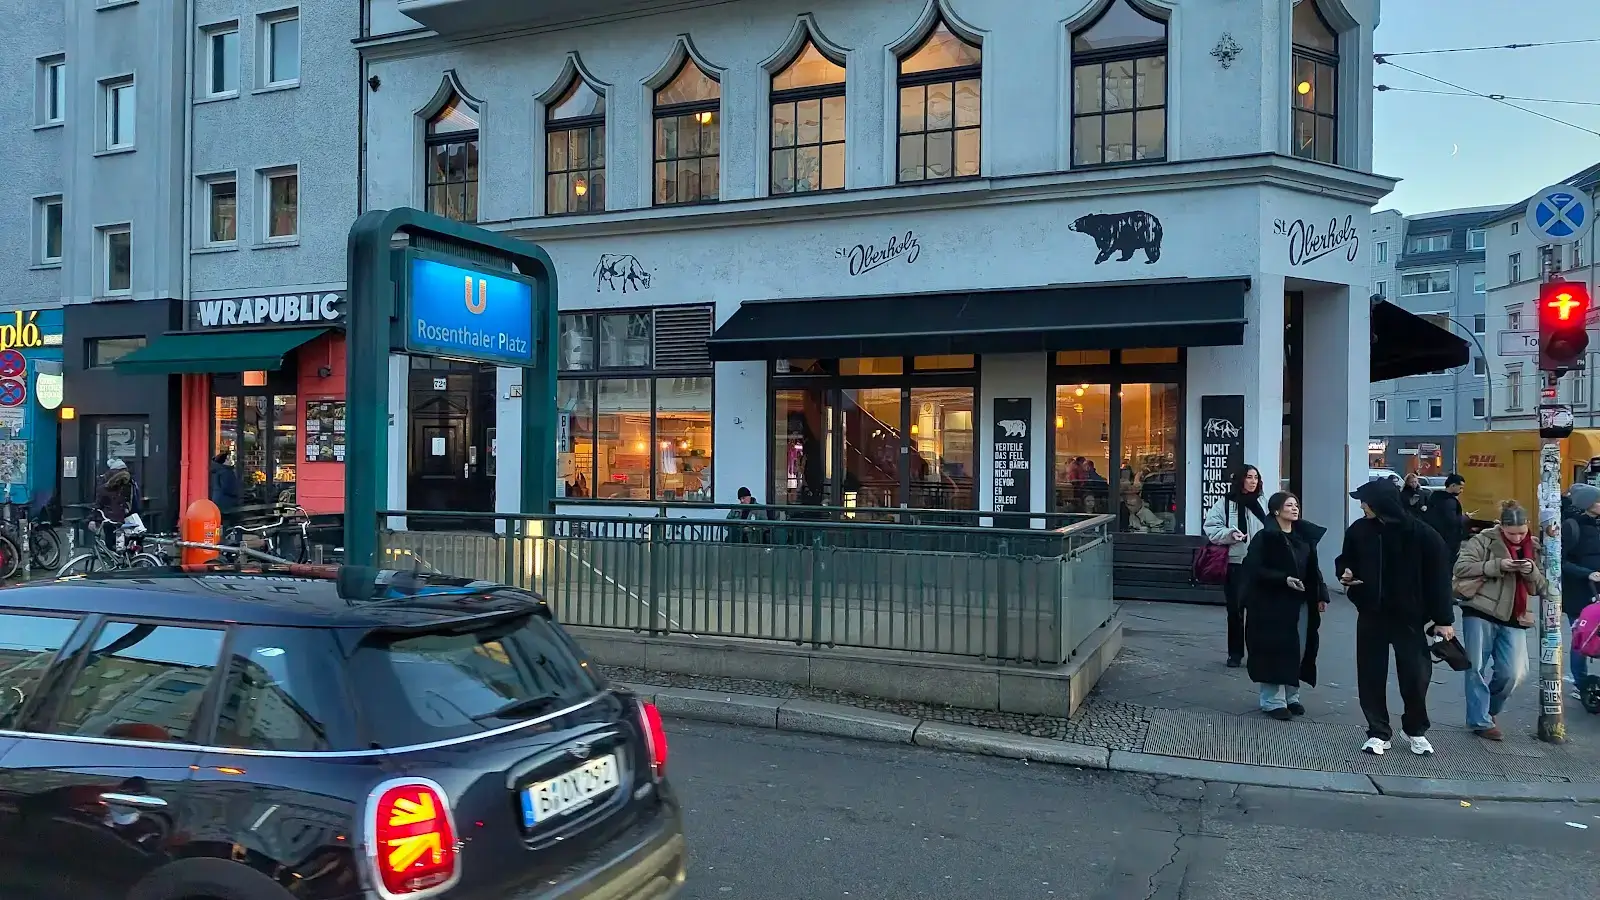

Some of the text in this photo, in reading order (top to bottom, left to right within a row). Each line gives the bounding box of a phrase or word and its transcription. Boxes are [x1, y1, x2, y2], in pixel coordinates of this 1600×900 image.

[1287, 214, 1359, 266] Oberholz
[848, 230, 920, 276] Oberholz
[464, 275, 487, 314] U
[199, 293, 340, 327] WRAPUBLIC
[417, 318, 527, 354] Rosenthaler Platz
[1522, 335, 1540, 347] To
[994, 442, 1024, 452] VERTEILE
[1203, 443, 1231, 456] NICHT
[994, 451, 1025, 460] DAS FELL
[994, 459, 1029, 470] DES BÄREN
[1203, 456, 1228, 469] JEDE
[994, 469, 1013, 478] NICHT
[1203, 468, 1222, 481] KUH
[994, 478, 1015, 487] BEVOR
[1202, 480, 1233, 495] LÄSST
[994, 486, 1003, 496] ER
[994, 495, 1018, 505] ERLEGT
[994, 504, 1005, 513] IST
[1544, 680, 1561, 691] MUY
[1544, 692, 1562, 702] BIEN
